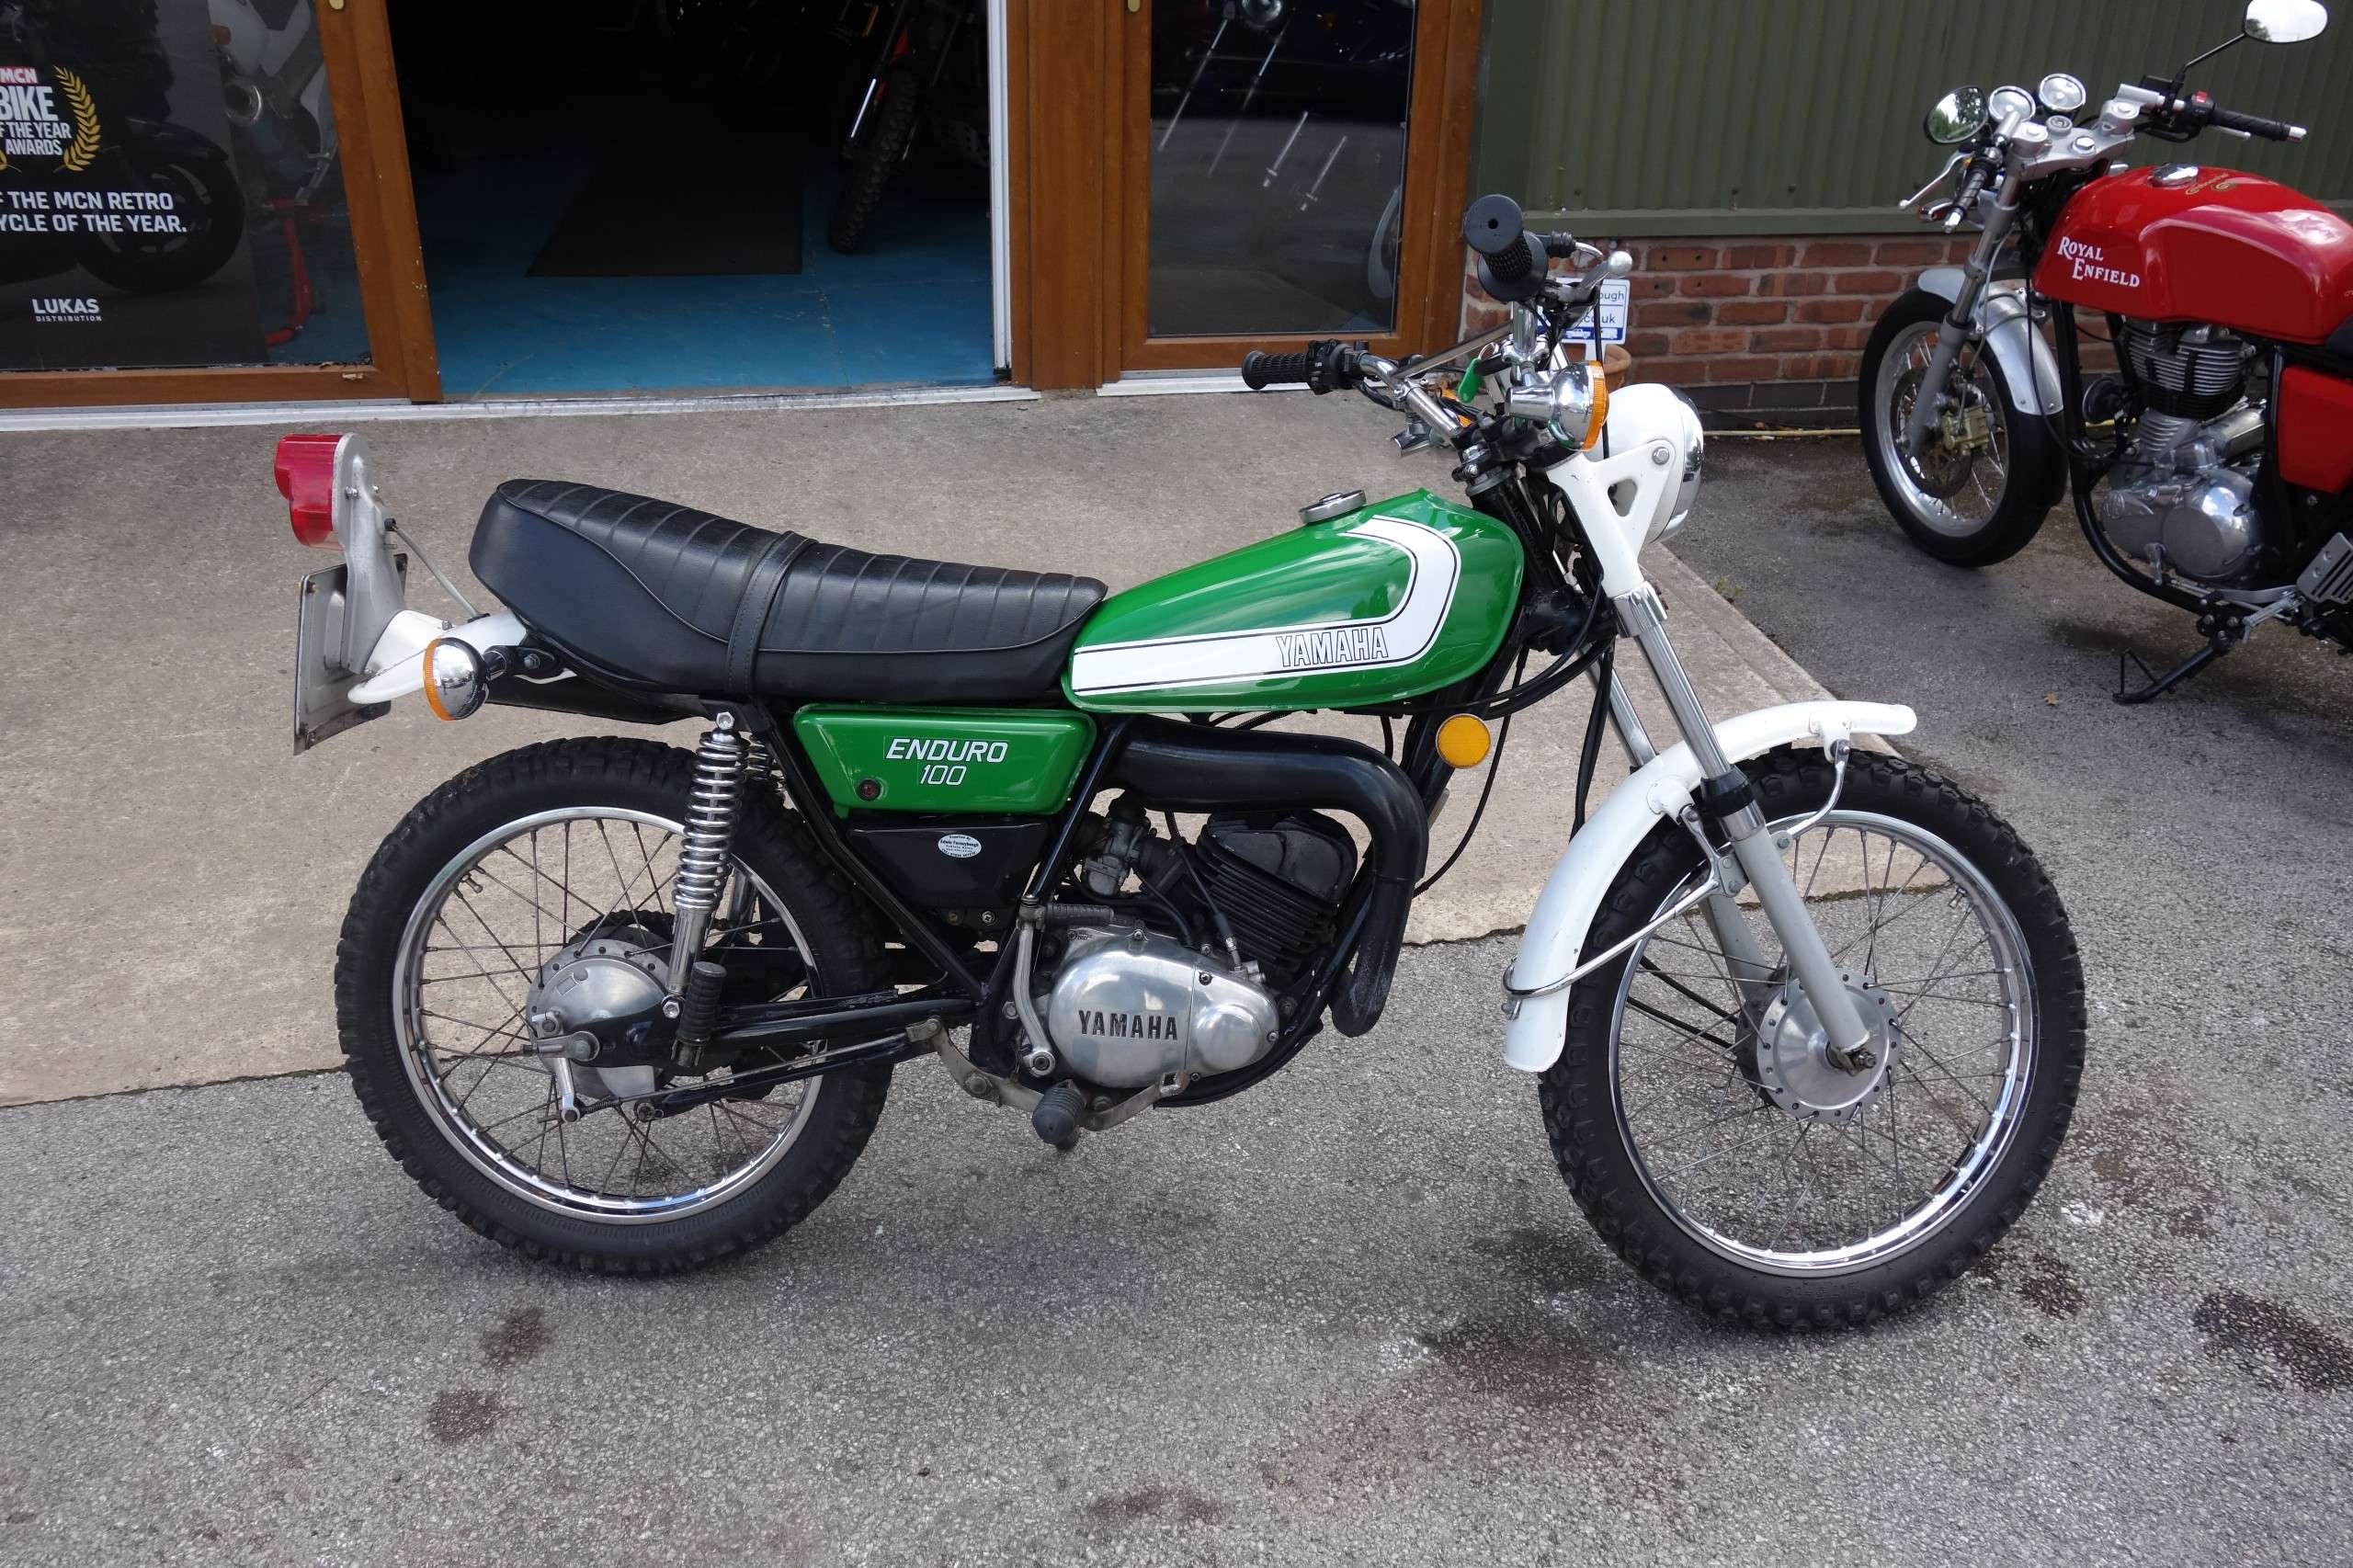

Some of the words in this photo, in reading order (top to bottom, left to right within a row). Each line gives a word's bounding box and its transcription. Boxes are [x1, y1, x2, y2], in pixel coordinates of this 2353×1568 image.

[0, 68, 39, 84] MCN
[0, 85, 59, 121] BIKE
[6, 121, 35, 139] THE
[34, 121, 73, 139] YEAR
[6, 139, 63, 155] AWARDS
[7, 191, 50, 210] THE
[53, 191, 104, 210] MCN
[107, 192, 175, 210] RETRO
[0, 213, 49, 232] YCLE
[51, 214, 79, 232] OF
[82, 214, 124, 232] THE
[126, 215, 188, 233] YEAR.
[2057, 236, 2104, 261] ROYAL
[2072, 257, 2141, 288] ENFIELD
[32, 299, 100, 313] LUKAS
[1599, 290, 1624, 302] ough
[1276, 626, 1389, 668] YAMAHA
[885, 738, 1008, 763] ENDURO
[920, 764, 967, 786] 100
[1078, 1010, 1177, 1040] YAMAHA
